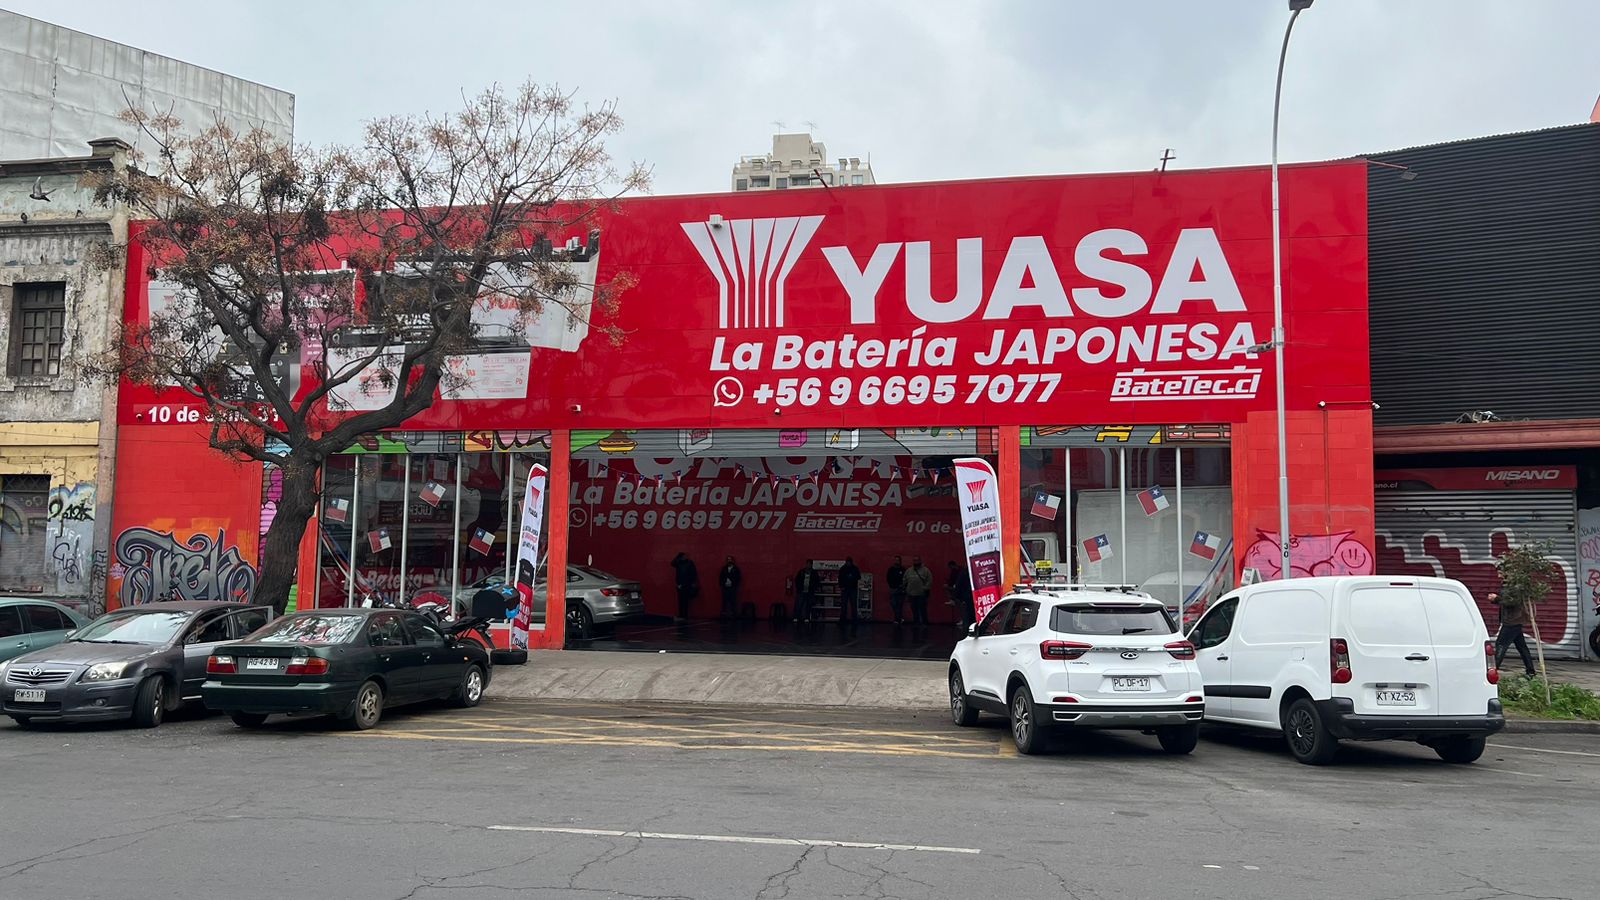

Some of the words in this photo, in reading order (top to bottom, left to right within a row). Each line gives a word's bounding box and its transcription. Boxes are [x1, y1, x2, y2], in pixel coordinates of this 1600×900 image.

[821, 228, 1247, 324] YUASA
[710, 337, 763, 370] La
[772, 325, 957, 369] Batería
[973, 322, 1259, 365] JAPONESA
[753, 378, 822, 406] +56
[829, 377, 851, 405] 9
[858, 375, 957, 405] 6695
[964, 373, 1062, 404] 7077
[1111, 375, 1261, 396] BateTec.cl
[148, 406, 171, 423] 10
[176, 406, 200, 422] de
[1485, 470, 1560, 481] MISANO
[614, 480, 728, 505] Batería
[734, 482, 902, 507] JAPONESA
[967, 502, 990, 512] YUASA
[593, 510, 638, 529] +56
[643, 511, 657, 529] 9
[661, 511, 723, 530] 6695
[728, 512, 787, 530] 7077
[795, 516, 882, 529] BateTec.cl
[906, 521, 926, 533] 10
[931, 521, 950, 533] de
